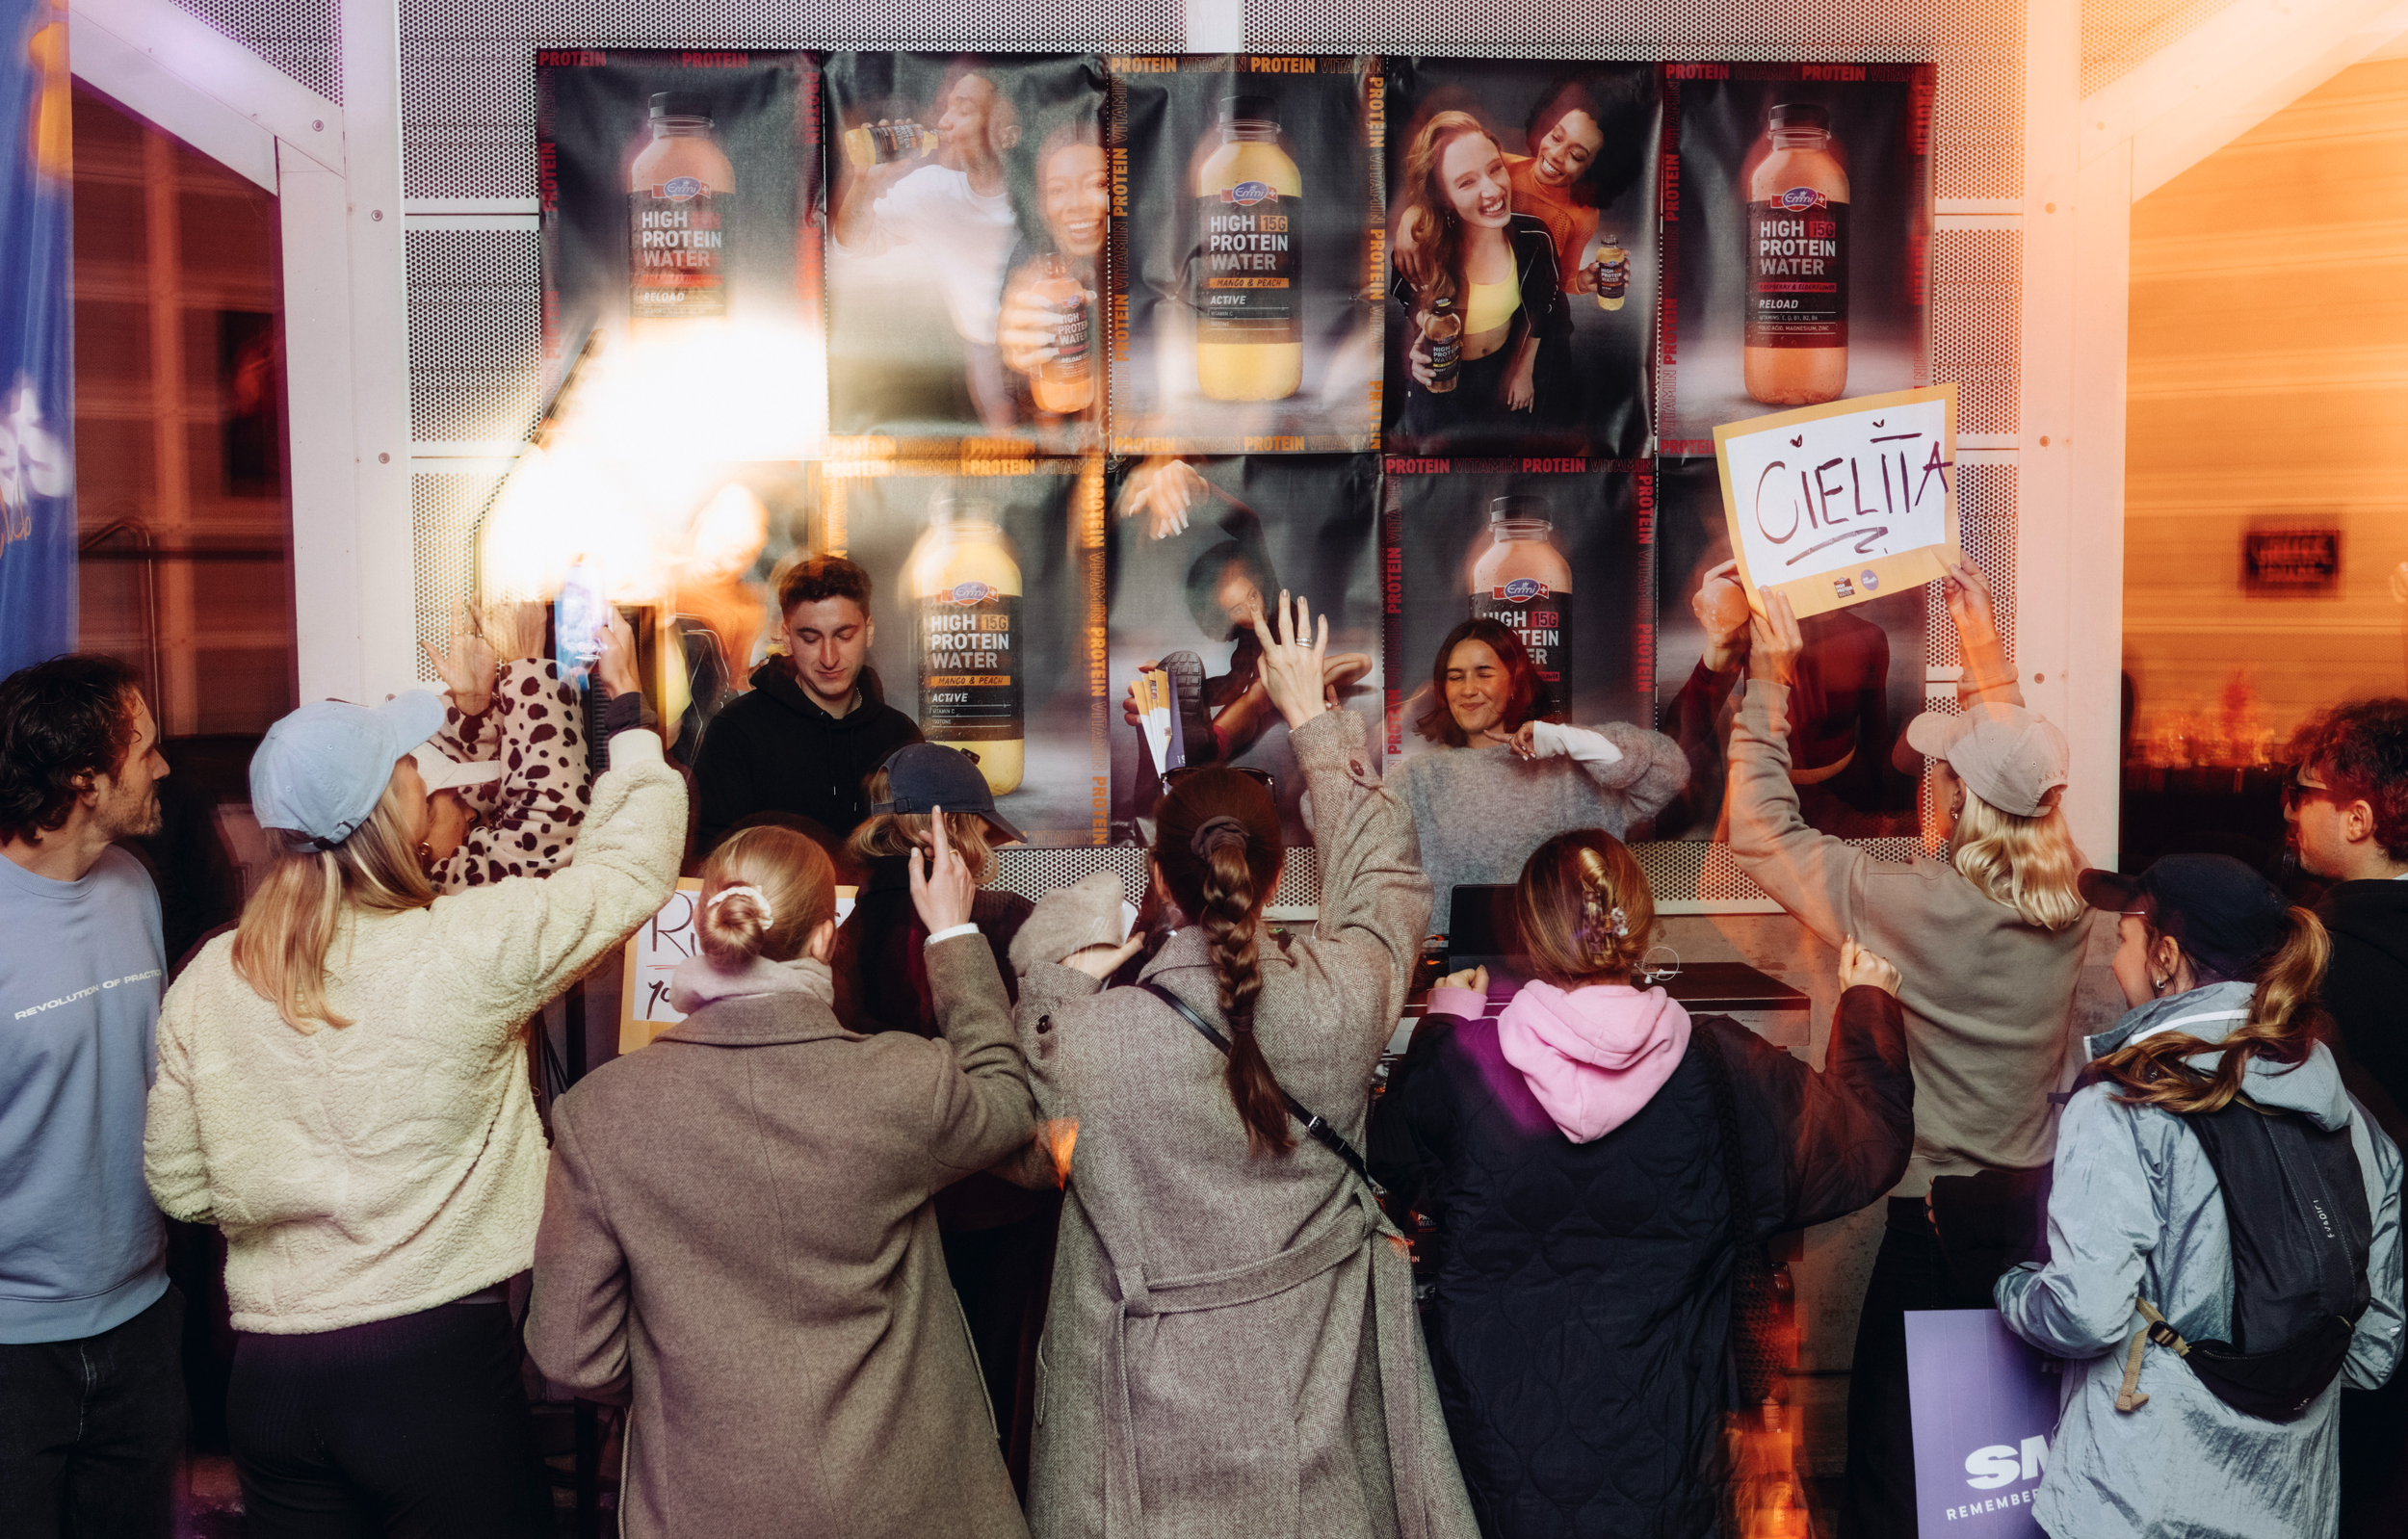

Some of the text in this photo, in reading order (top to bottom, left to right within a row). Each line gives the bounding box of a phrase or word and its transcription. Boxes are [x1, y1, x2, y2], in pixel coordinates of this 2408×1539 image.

[539, 52, 606, 67] PROTEIN
[682, 52, 748, 68] PROTEIN
[1112, 56, 1385, 74] PROTEIN VITAMIN PROTEIN VITAMIN
[1665, 64, 1730, 80] PROTEIN
[1802, 65, 1866, 81] PROTEIN
[805, 72, 821, 144] PROTEIN
[1112, 76, 1128, 143] VITAMIN
[1369, 77, 1385, 147] PROTEIN
[1917, 84, 1932, 155] PROTEIN
[540, 143, 559, 212] PROTEIN
[1112, 147, 1129, 217] PROTEIN
[667, 182, 697, 194] Emmi
[1235, 186, 1267, 197] Emmi
[1369, 152, 1386, 224] VITAMIN
[1664, 154, 1680, 222] PROTEIN
[1785, 193, 1815, 204] Emmi
[641, 210, 688, 228] HIGH
[1210, 215, 1286, 232] HIGH 15G
[1760, 221, 1834, 237] HIGH 15G
[642, 230, 721, 248] PROTEIN
[1210, 234, 1288, 251] PROTEIN
[1113, 222, 1129, 289] VITAMIN
[1760, 240, 1836, 257] PROTEIN
[643, 249, 710, 267] WATER
[1211, 253, 1276, 271] WATER
[1370, 229, 1385, 300] PROTEIN
[1760, 259, 1824, 275] WATER
[643, 292, 685, 302] RELOAD
[1210, 295, 1246, 305] ACTIVE
[1759, 300, 1799, 309] RELOAD
[544, 290, 562, 359] PROTEIN
[1058, 319, 1088, 335] PROTE
[1114, 294, 1130, 362] PROTEIN
[1662, 298, 1679, 365] PROTEIN
[1661, 370, 1678, 437] VITAMIN
[1369, 380, 1384, 450] PROTEIN
[1114, 436, 1176, 453] PROTEIN
[1244, 435, 1305, 452] PROTEIN
[970, 458, 1035, 475] PROTEIN
[1386, 458, 1450, 474] PROTEIN
[1454, 457, 1518, 474] VITAMIN
[1522, 457, 1586, 474] PROTEIN
[1638, 475, 1654, 544] PROTEIN
[1387, 547, 1401, 613] PROTEIN
[1638, 549, 1654, 618] VITAMIN
[955, 586, 985, 598] Emmi
[1506, 584, 1537, 595] Emmi
[931, 613, 1008, 632] HIGH 15G
[1534, 613, 1557, 626] 15G
[931, 633, 1009, 650] PROTEIN
[1512, 629, 1558, 646] TEIN
[932, 651, 998, 668] WATER
[1089, 477, 1108, 845] PROTEIN VITAMIN PROTEIN VITAMIN PROTEIN
[1637, 623, 1653, 692] PROTEIN
[938, 676, 1004, 685] MANGO & PEACH
[931, 692, 968, 703] ACTIVE
[1387, 689, 1402, 755] PROTEIN
[14, 984, 99, 1021] REVOLUTION
[102, 978, 121, 989] OF
